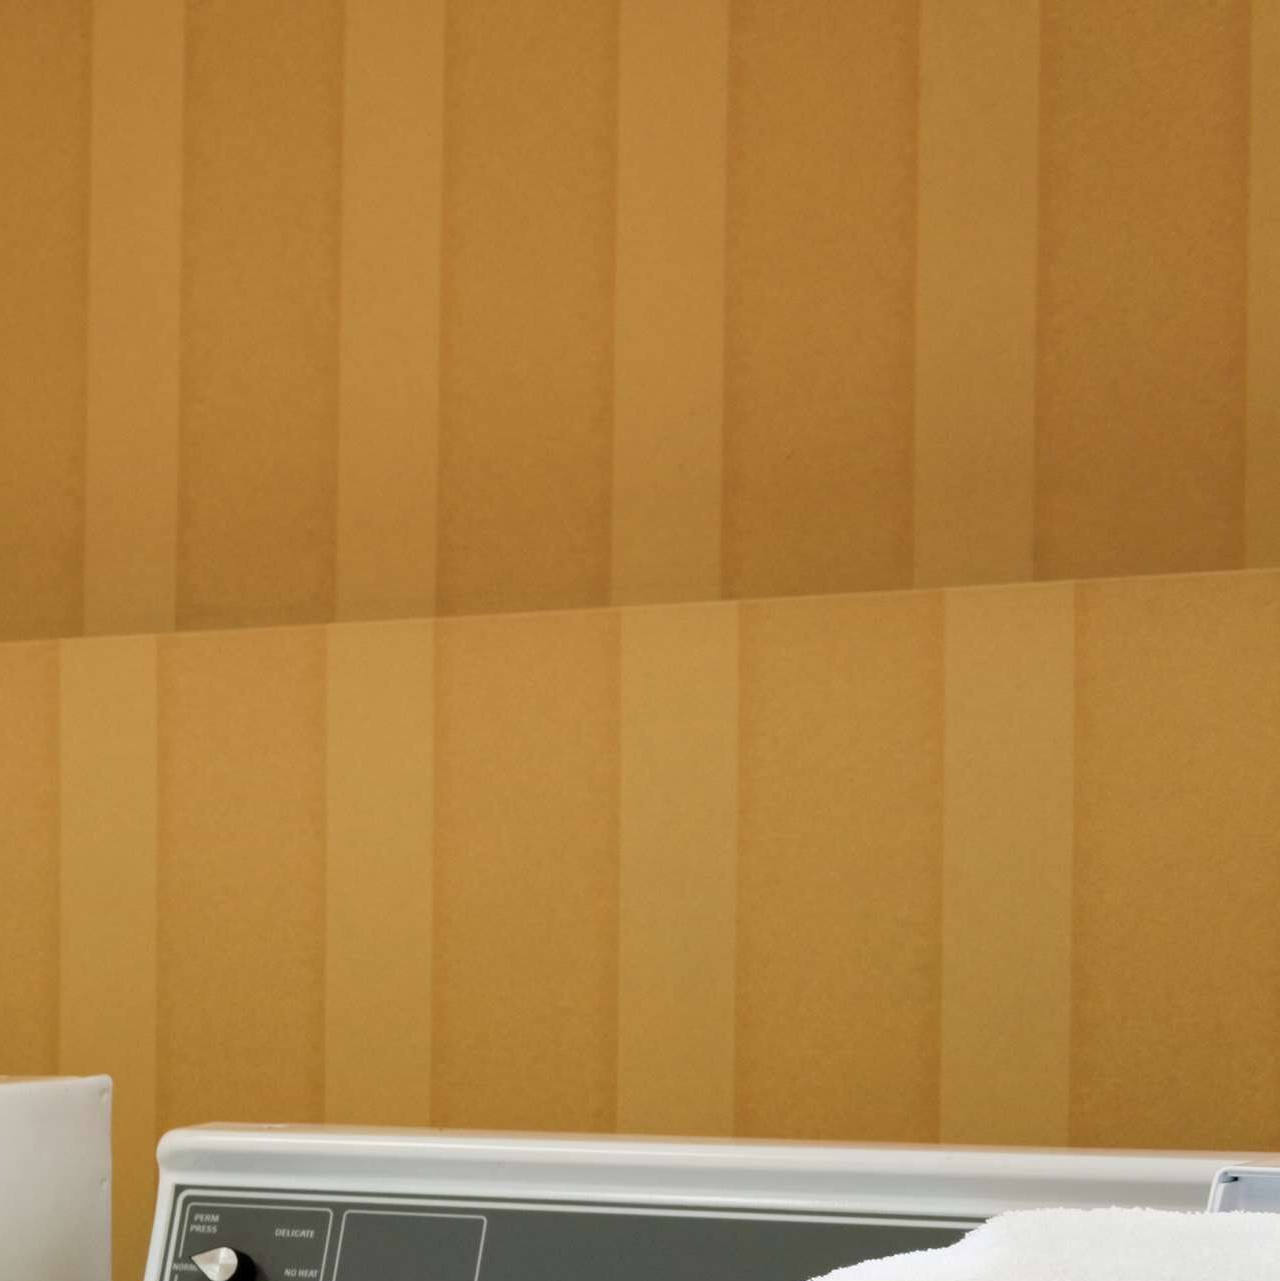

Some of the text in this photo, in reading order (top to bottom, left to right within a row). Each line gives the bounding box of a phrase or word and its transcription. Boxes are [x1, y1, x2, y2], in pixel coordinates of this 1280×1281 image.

[194, 1213, 220, 1223] PERM
[190, 1224, 218, 1234] PRESS
[274, 1228, 315, 1239] DELICATE
[284, 1268, 318, 1279] NO HEAT
